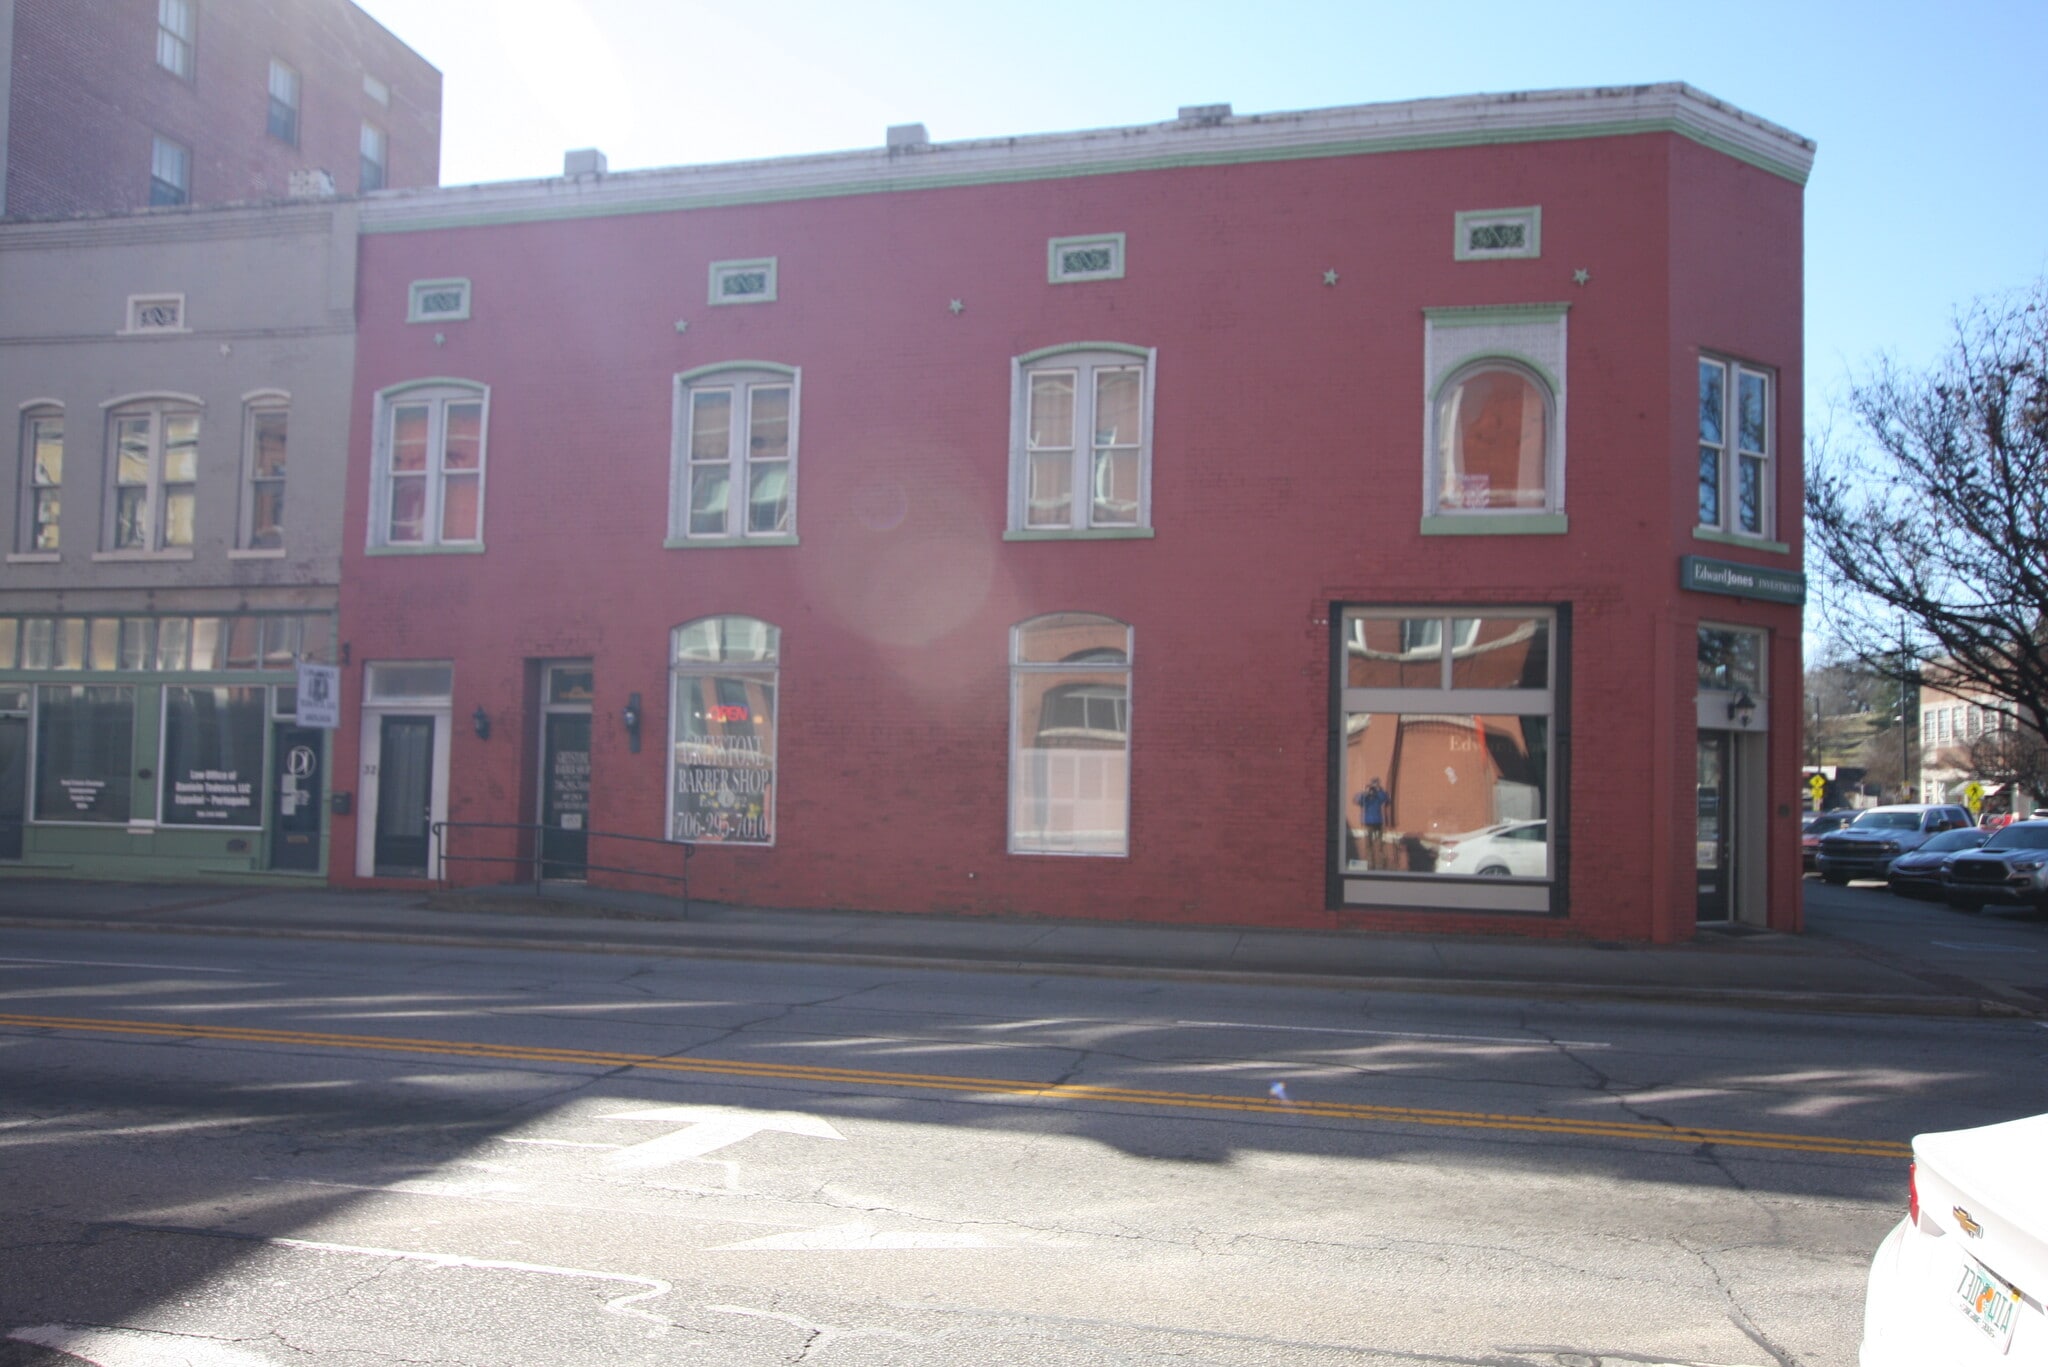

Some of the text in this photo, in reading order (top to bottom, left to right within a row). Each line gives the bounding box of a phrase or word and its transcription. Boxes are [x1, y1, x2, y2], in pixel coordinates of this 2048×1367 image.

[709, 704, 749, 722] OPEN
[682, 735, 765, 767] GREYSTONE
[678, 768, 769, 793] BARBER SHOP
